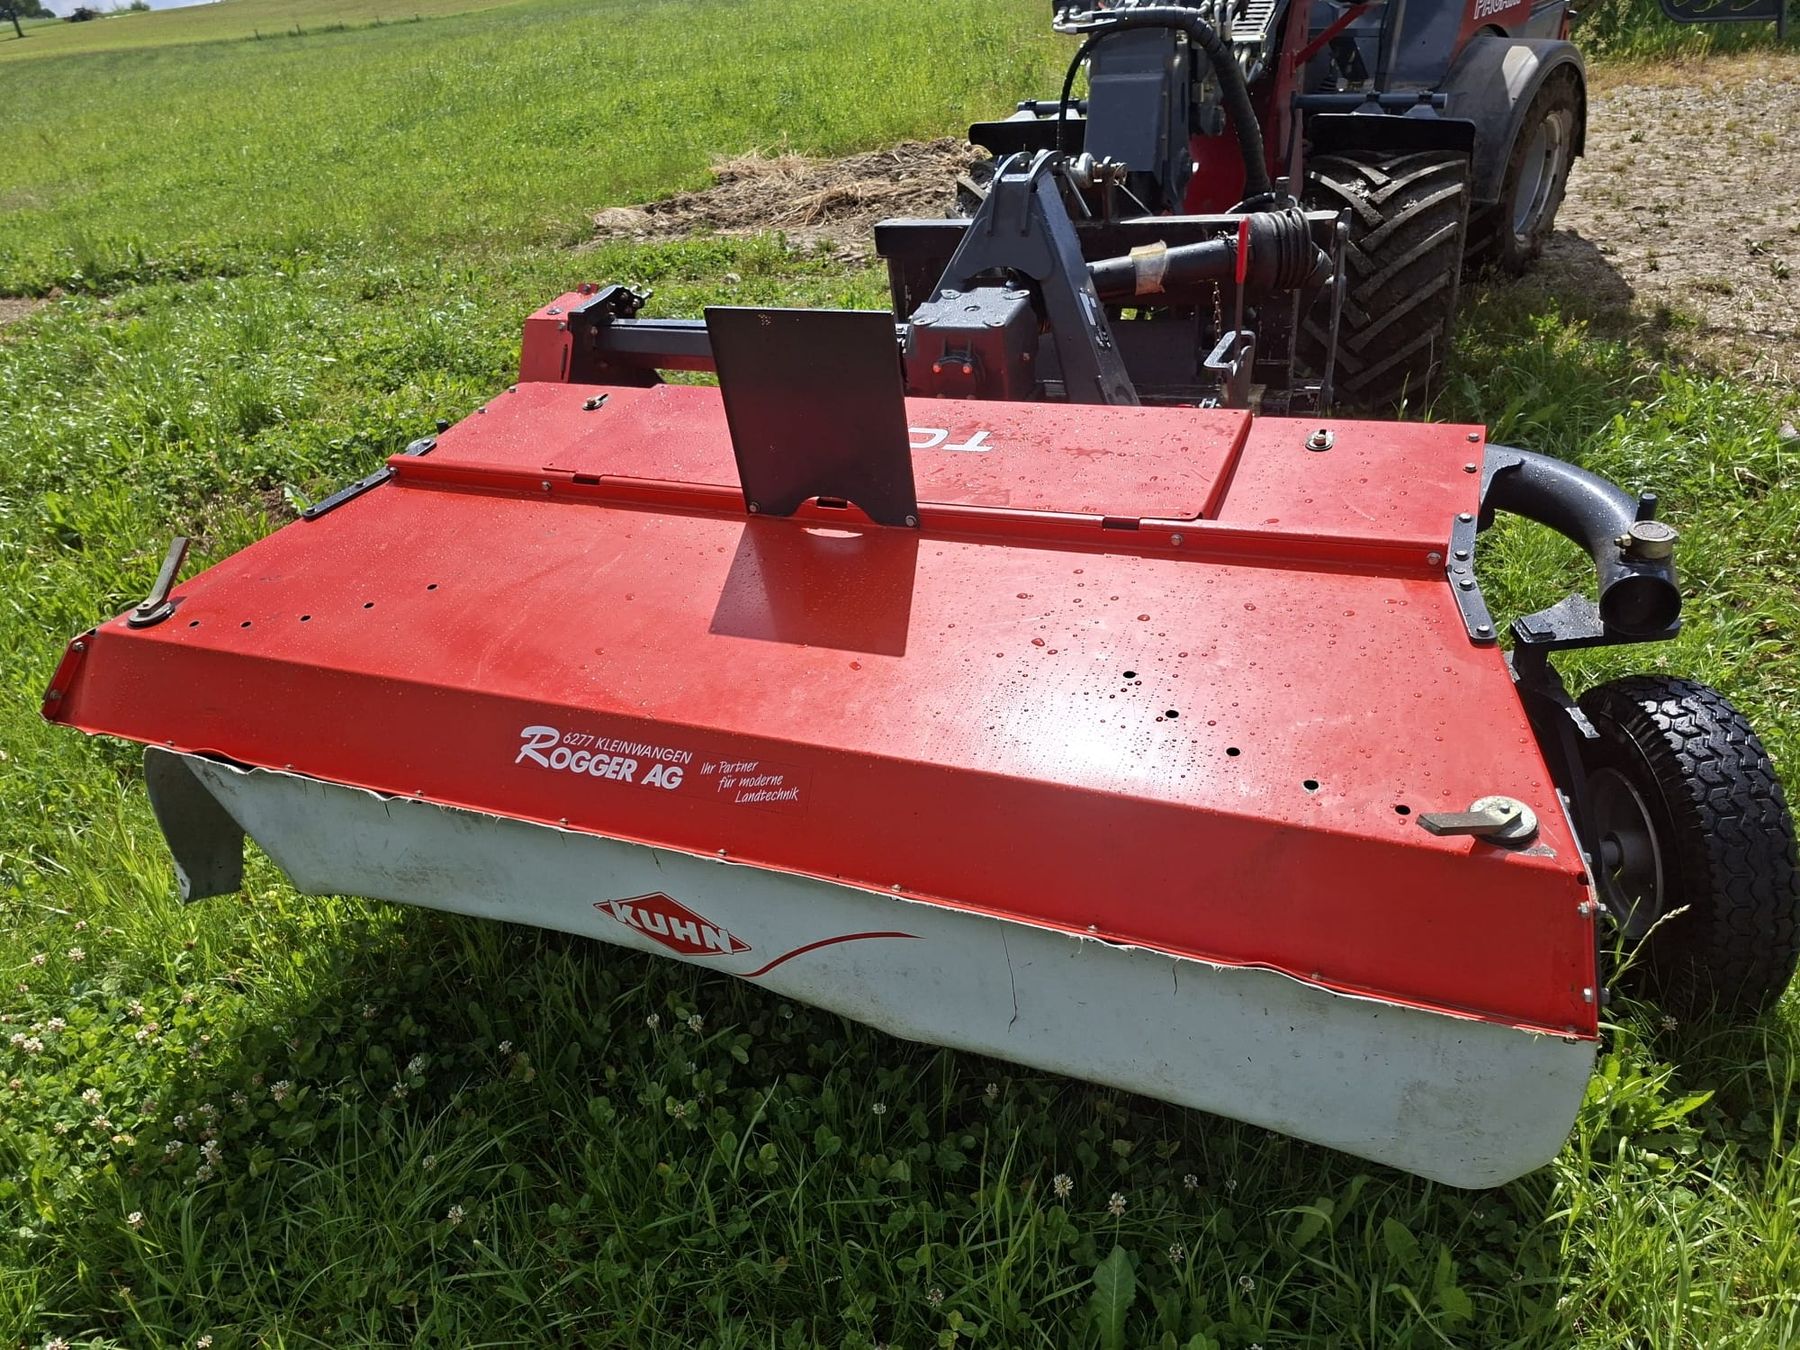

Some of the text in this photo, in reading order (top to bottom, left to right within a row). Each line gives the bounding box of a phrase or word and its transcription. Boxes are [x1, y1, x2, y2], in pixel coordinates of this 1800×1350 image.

[515, 725, 684, 790] ROGGER AG
[563, 732, 693, 765] 6277 KLEINWANGEN
[700, 760, 759, 775] Ihr Partner
[717, 774, 783, 793] für moderne
[735, 787, 800, 803] Landtechnik
[609, 899, 735, 955] KUHN
